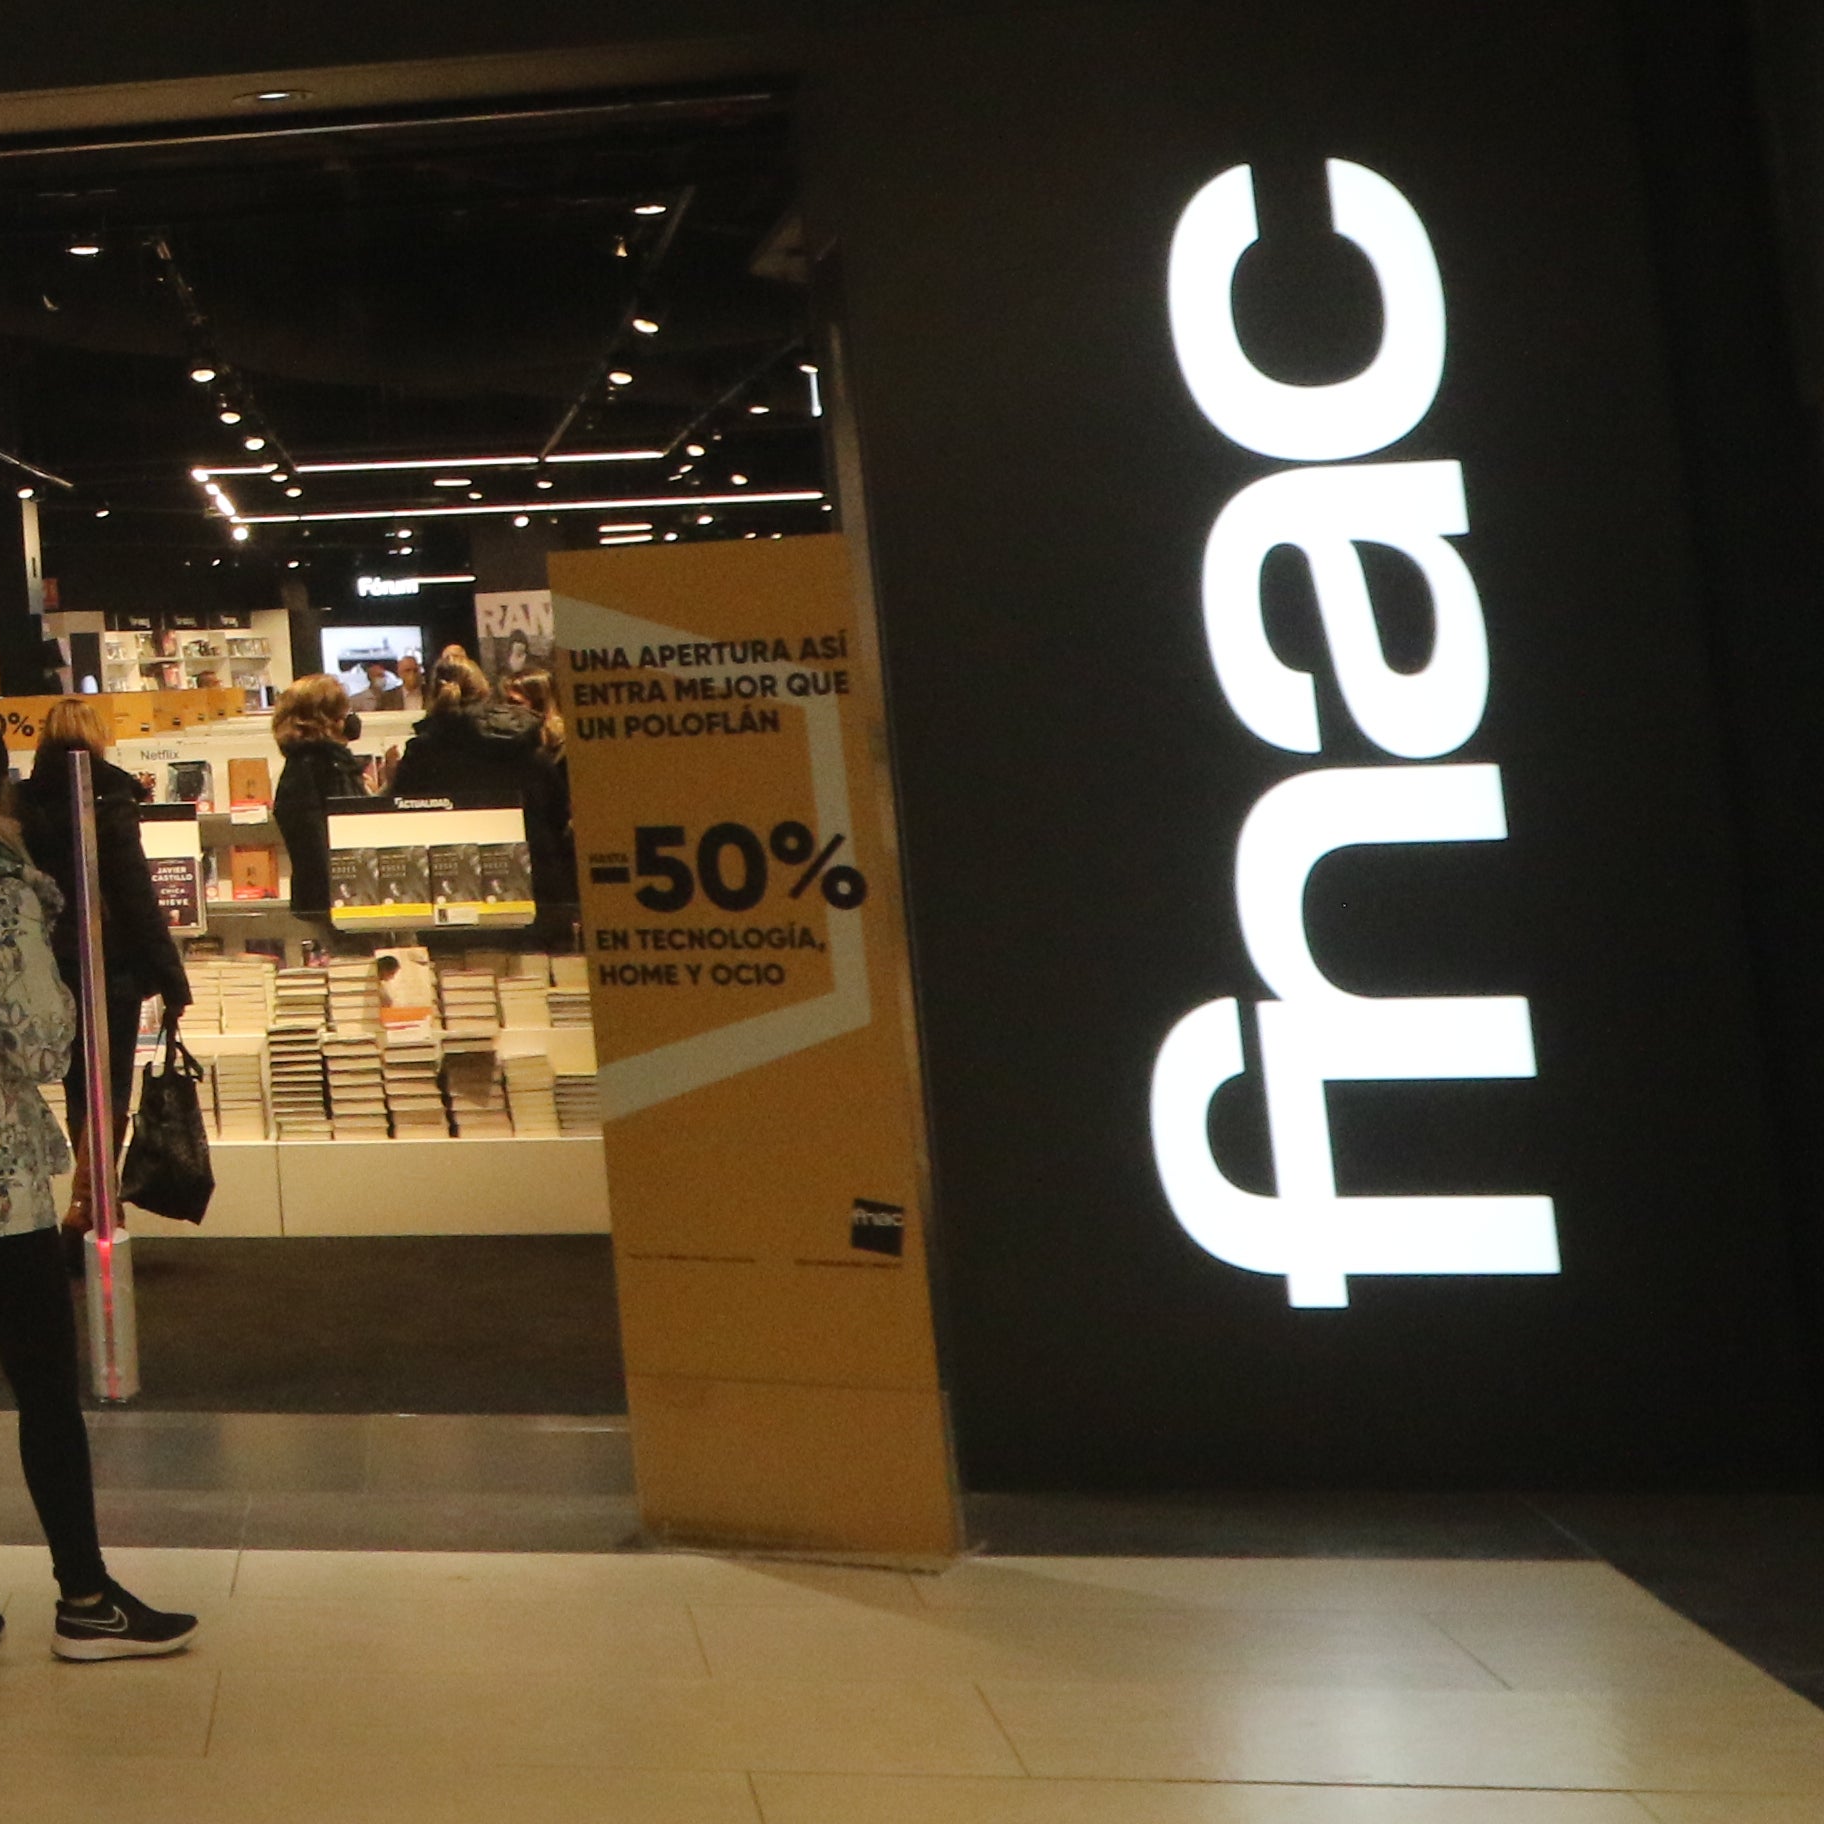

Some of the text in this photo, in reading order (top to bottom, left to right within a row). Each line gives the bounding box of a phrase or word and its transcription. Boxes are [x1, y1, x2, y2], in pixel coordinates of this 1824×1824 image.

[357, 576, 420, 596] Fórum
[570, 629, 848, 673] UNA APERTURA ASÍ
[573, 670, 849, 707] ENTRA MEJOR QUE
[576, 704, 780, 742] UN POLOFLÁN
[1149, 158, 1561, 1308] fnac
[140, 749, 179, 761] Netflix
[398, 798, 451, 809] ACTUALIDAD
[151, 874, 193, 882] CASTILLO
[158, 866, 187, 874] JAVIER
[590, 820, 868, 913] -50%
[596, 921, 826, 953] EN TECNOLOGÍA,
[599, 962, 786, 987] HOME Y OCIO
